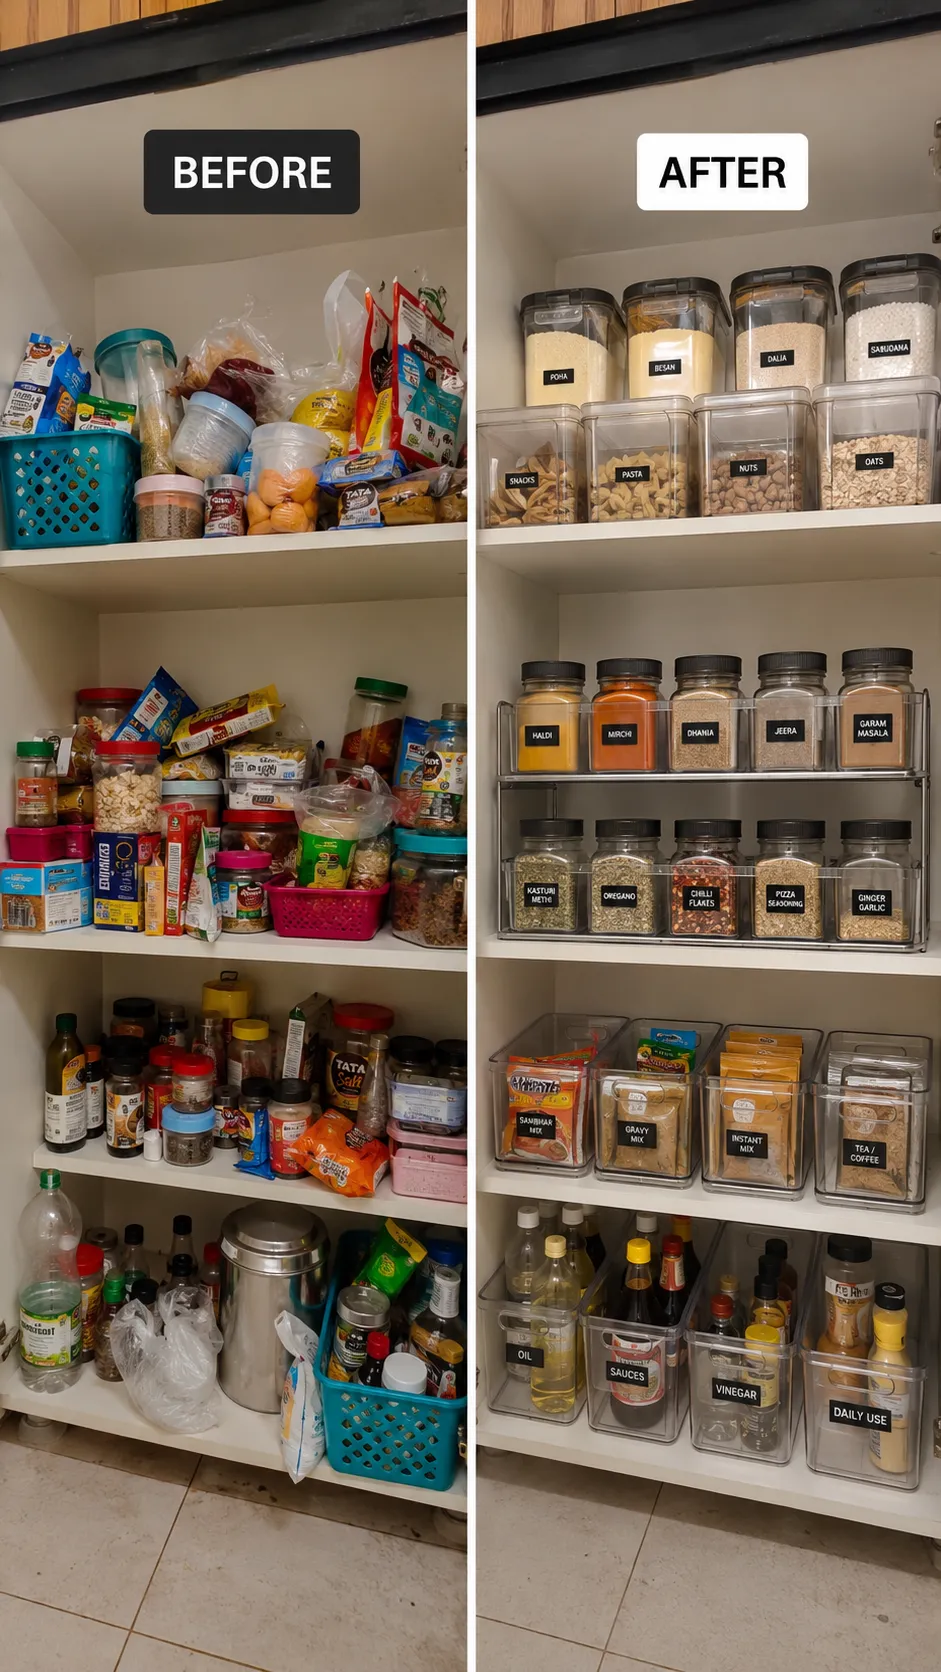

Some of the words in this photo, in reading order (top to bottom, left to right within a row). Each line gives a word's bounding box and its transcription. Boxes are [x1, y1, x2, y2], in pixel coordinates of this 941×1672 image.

[767, 354, 787, 363] DALIA
[654, 363, 676, 373] BESAN
[550, 373, 568, 381] POHA
[865, 457, 884, 466] OATS
[739, 463, 758, 473] NUTS
[621, 470, 643, 479] PASTA
[509, 476, 536, 485] SNACKS
[345, 488, 372, 499] TATA
[859, 719, 887, 728] GARAM
[532, 731, 553, 740] HALDI
[607, 730, 633, 738] MIRCHI
[687, 729, 715, 737] DHANIA
[774, 727, 798, 735] JEERA
[857, 729, 889, 737] MASALA
[527, 887, 556, 895] KASTURI
[775, 890, 796, 899] PIZZA
[688, 899, 715, 907] FLAKES
[858, 894, 886, 903] GINGER
[858, 903, 886, 912] GARLIC
[335, 1058, 366, 1074] TATA
[625, 1125, 649, 1135] GRAVY
[630, 1135, 644, 1144] MIX
[731, 1134, 763, 1144] INSTANT
[739, 1145, 754, 1153] MIX
[854, 1144, 870, 1154] TEA
[850, 1153, 880, 1164] COFFEE
[517, 1350, 533, 1361] OIL
[610, 1367, 645, 1382] SAUCES
[715, 1384, 757, 1401] VINEGAR
[833, 1407, 864, 1422] DAILY
[866, 1413, 888, 1426] USE
